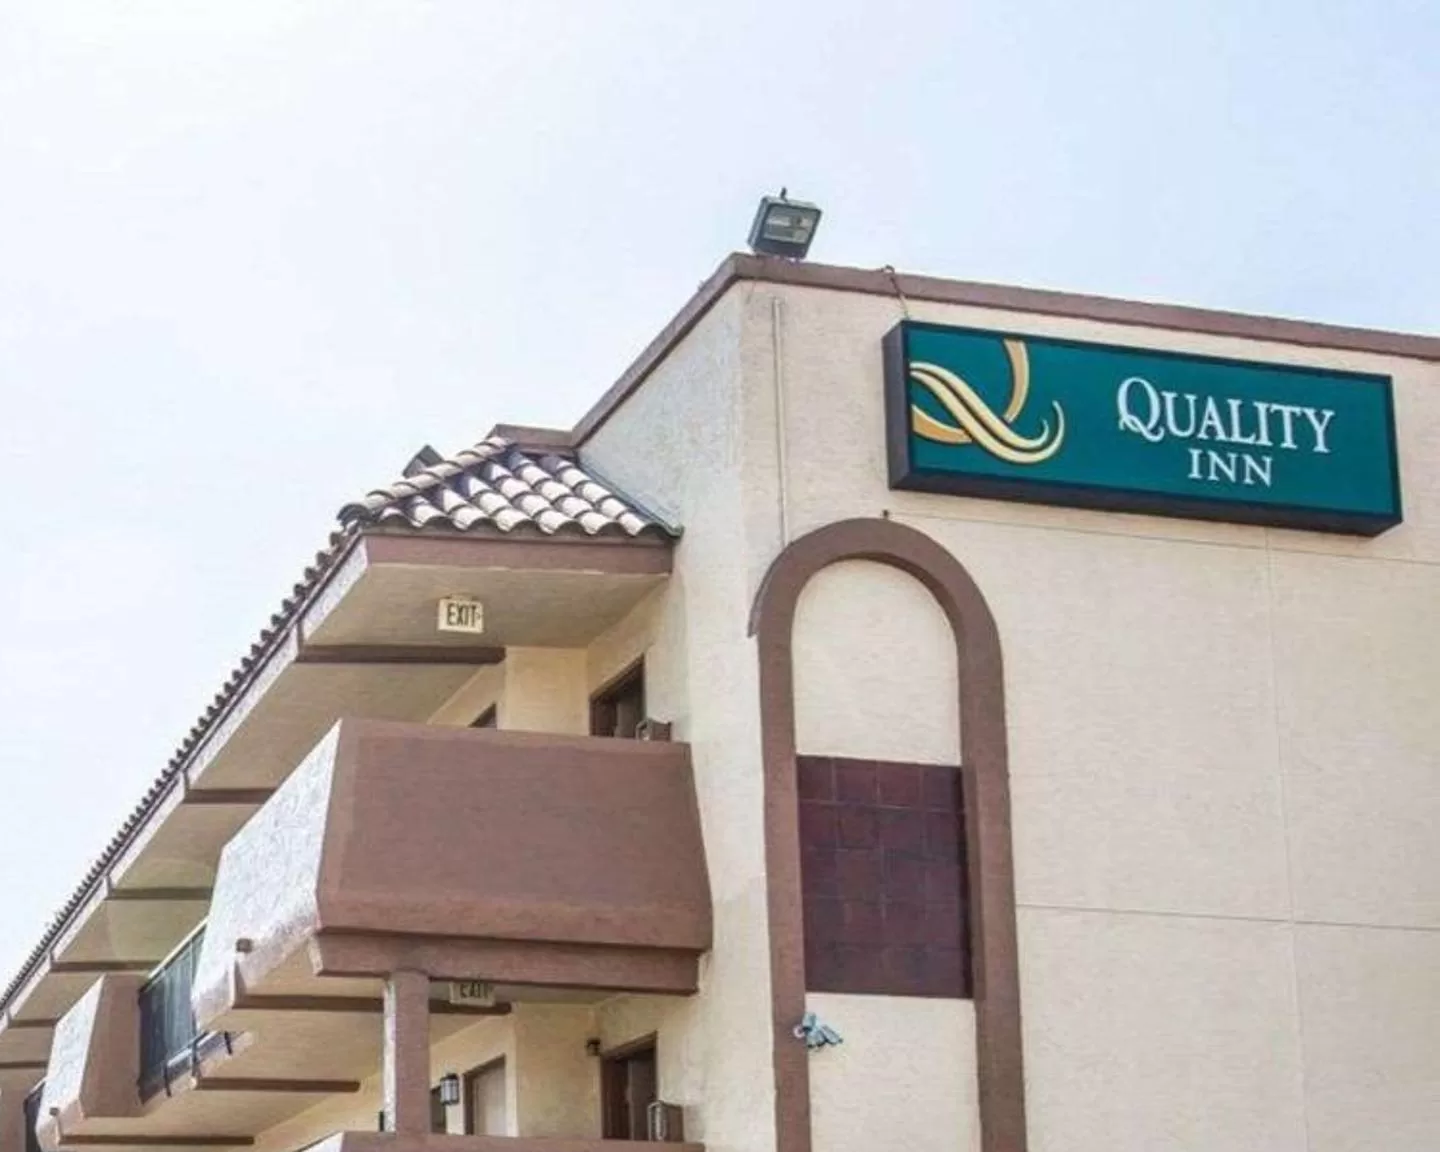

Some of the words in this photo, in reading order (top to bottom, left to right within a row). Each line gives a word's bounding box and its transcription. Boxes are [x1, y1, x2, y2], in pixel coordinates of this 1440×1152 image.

[1117, 377, 1335, 453] QUALITY
[1187, 448, 1273, 487] INN
[447, 602, 477, 627] EXIT
